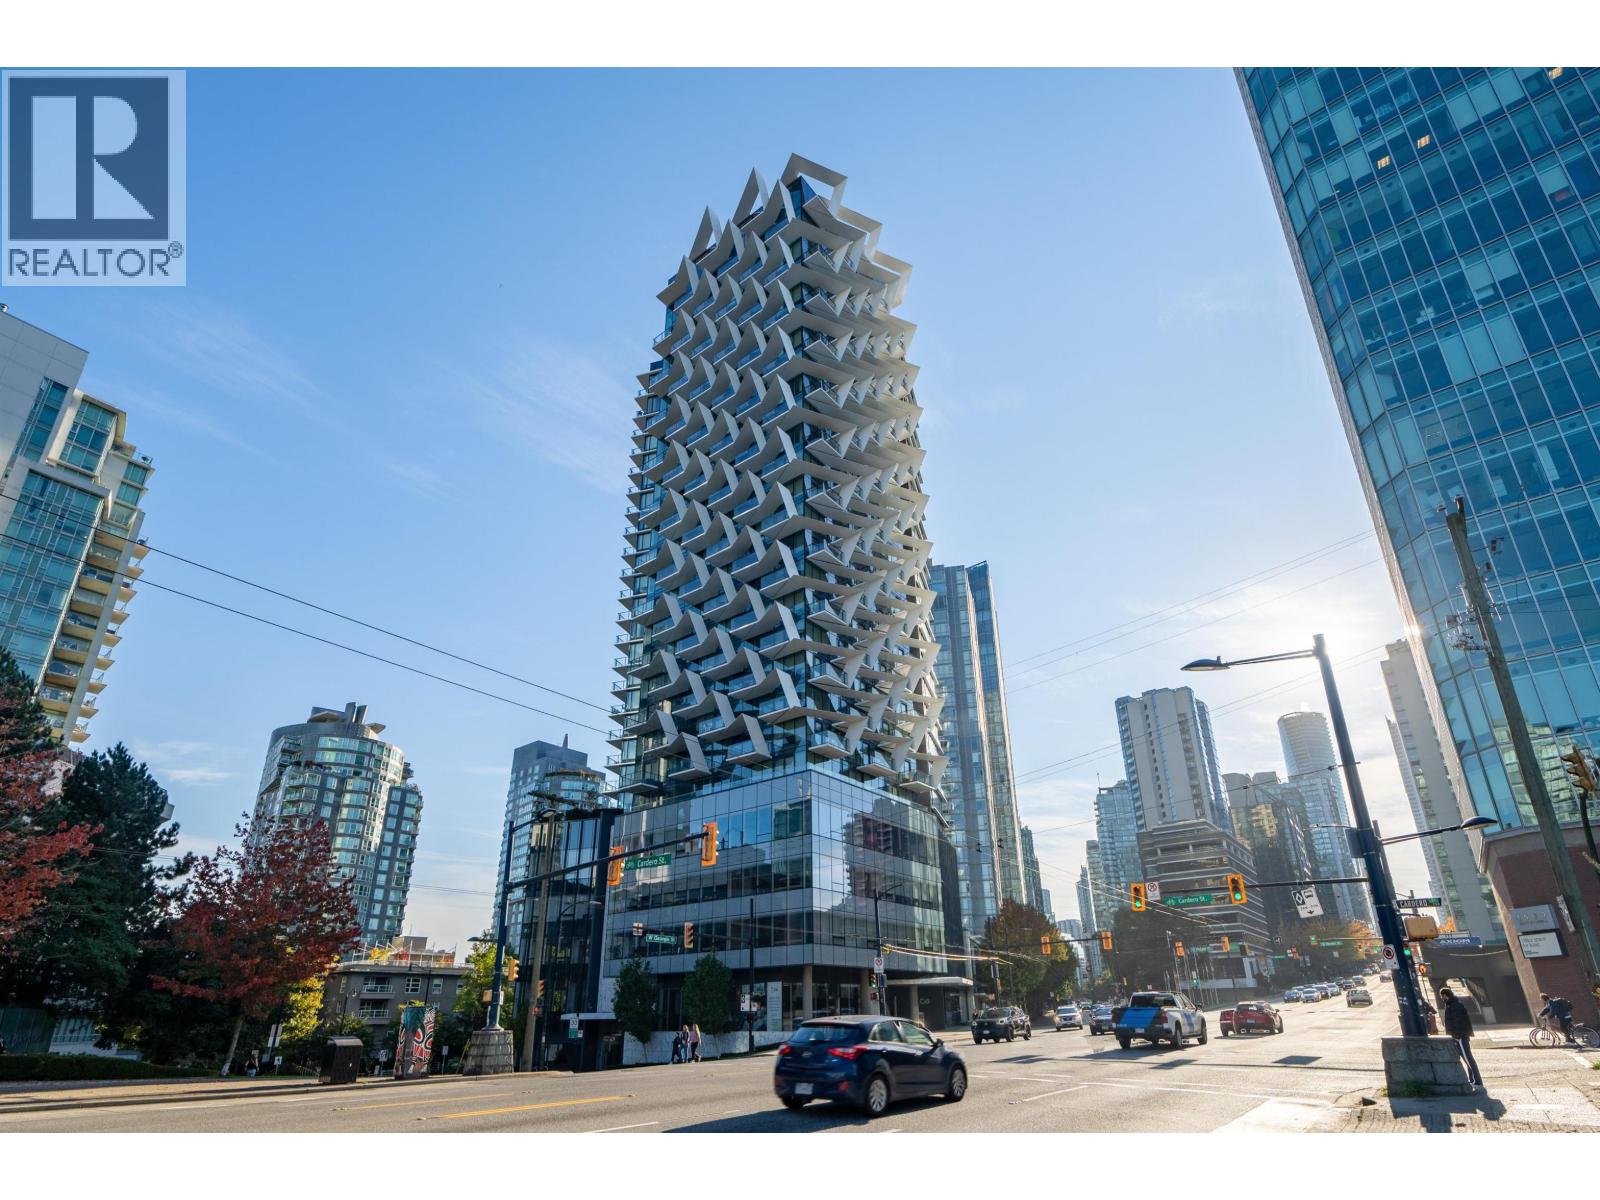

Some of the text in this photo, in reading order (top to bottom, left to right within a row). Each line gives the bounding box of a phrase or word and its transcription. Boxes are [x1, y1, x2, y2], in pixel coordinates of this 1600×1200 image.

[637, 858, 658, 868] Cardero
[1178, 895, 1199, 904] Cardero
[1400, 900, 1427, 908] CARDERO
